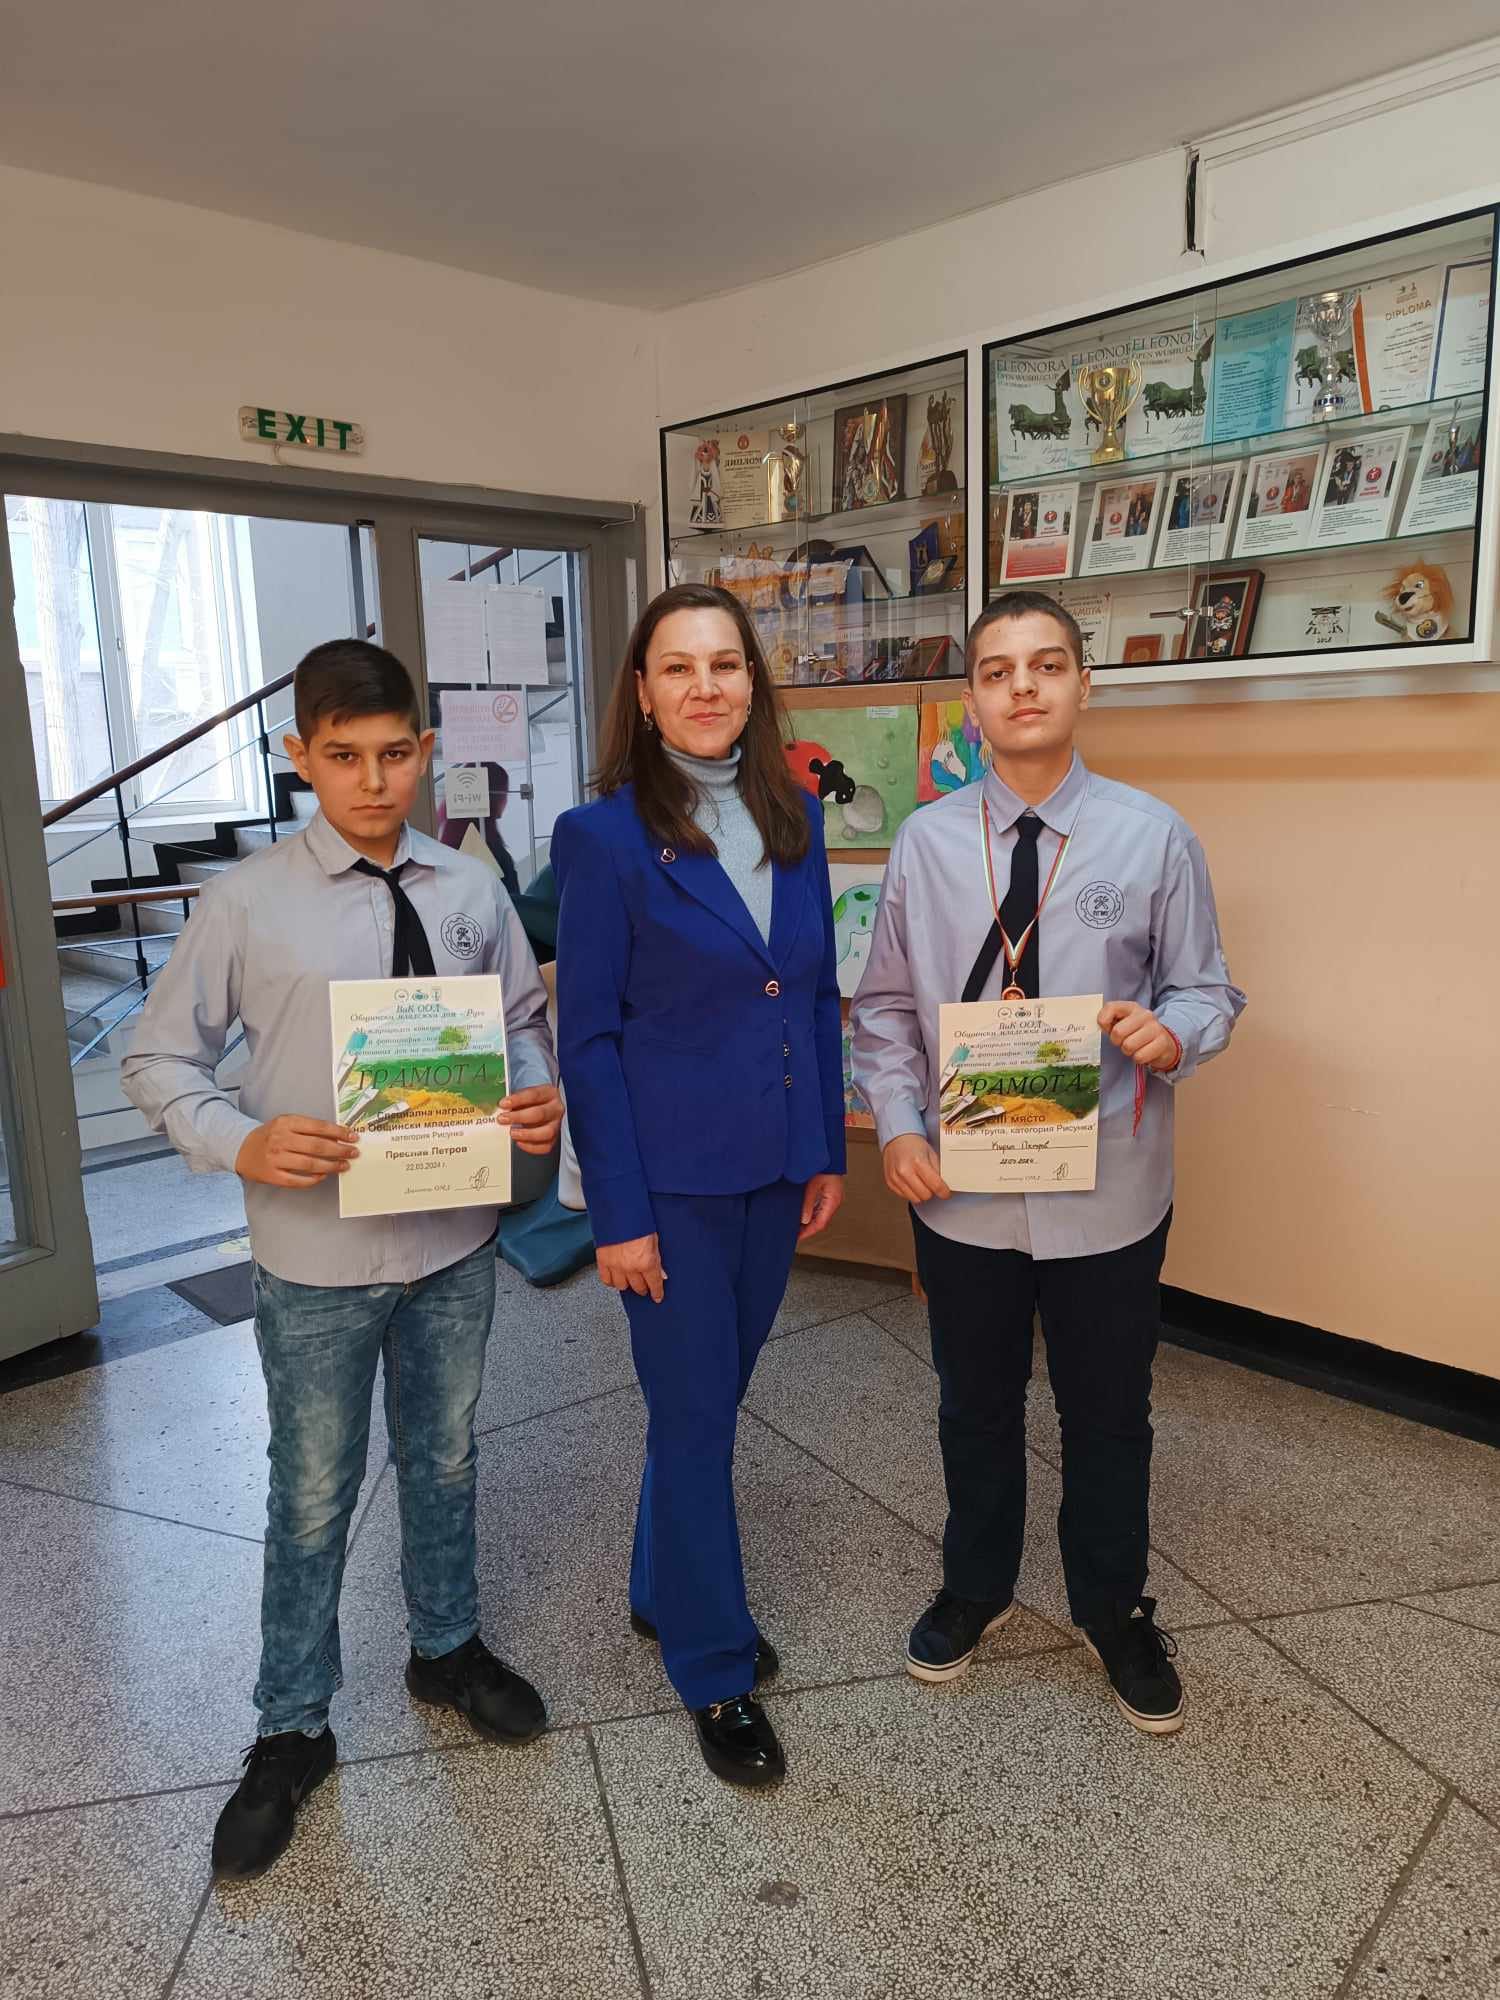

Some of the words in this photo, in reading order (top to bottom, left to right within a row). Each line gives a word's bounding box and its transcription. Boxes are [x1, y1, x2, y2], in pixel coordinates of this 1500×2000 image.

[1385, 300, 1432, 321] DIPLOMA
[1134, 328, 1207, 350] ELEONORA
[996, 359, 1067, 372] ELEONORA
[256, 407, 353, 450] EXIT
[359, 1064, 488, 1090] ГРАМОТА
[959, 1075, 1082, 1096] ГРАМОТА
[377, 1110, 432, 1121] Специална
[433, 1106, 475, 1117] награда
[1010, 1113, 1046, 1124] място
[368, 1123, 421, 1134] Общински
[424, 1119, 474, 1128] младежки
[476, 1116, 496, 1126] дом
[1010, 1125, 1054, 1135] категория
[432, 1129, 464, 1140] Рисунка
[385, 1150, 429, 1160] Преслав
[431, 1146, 468, 1157] Петров
